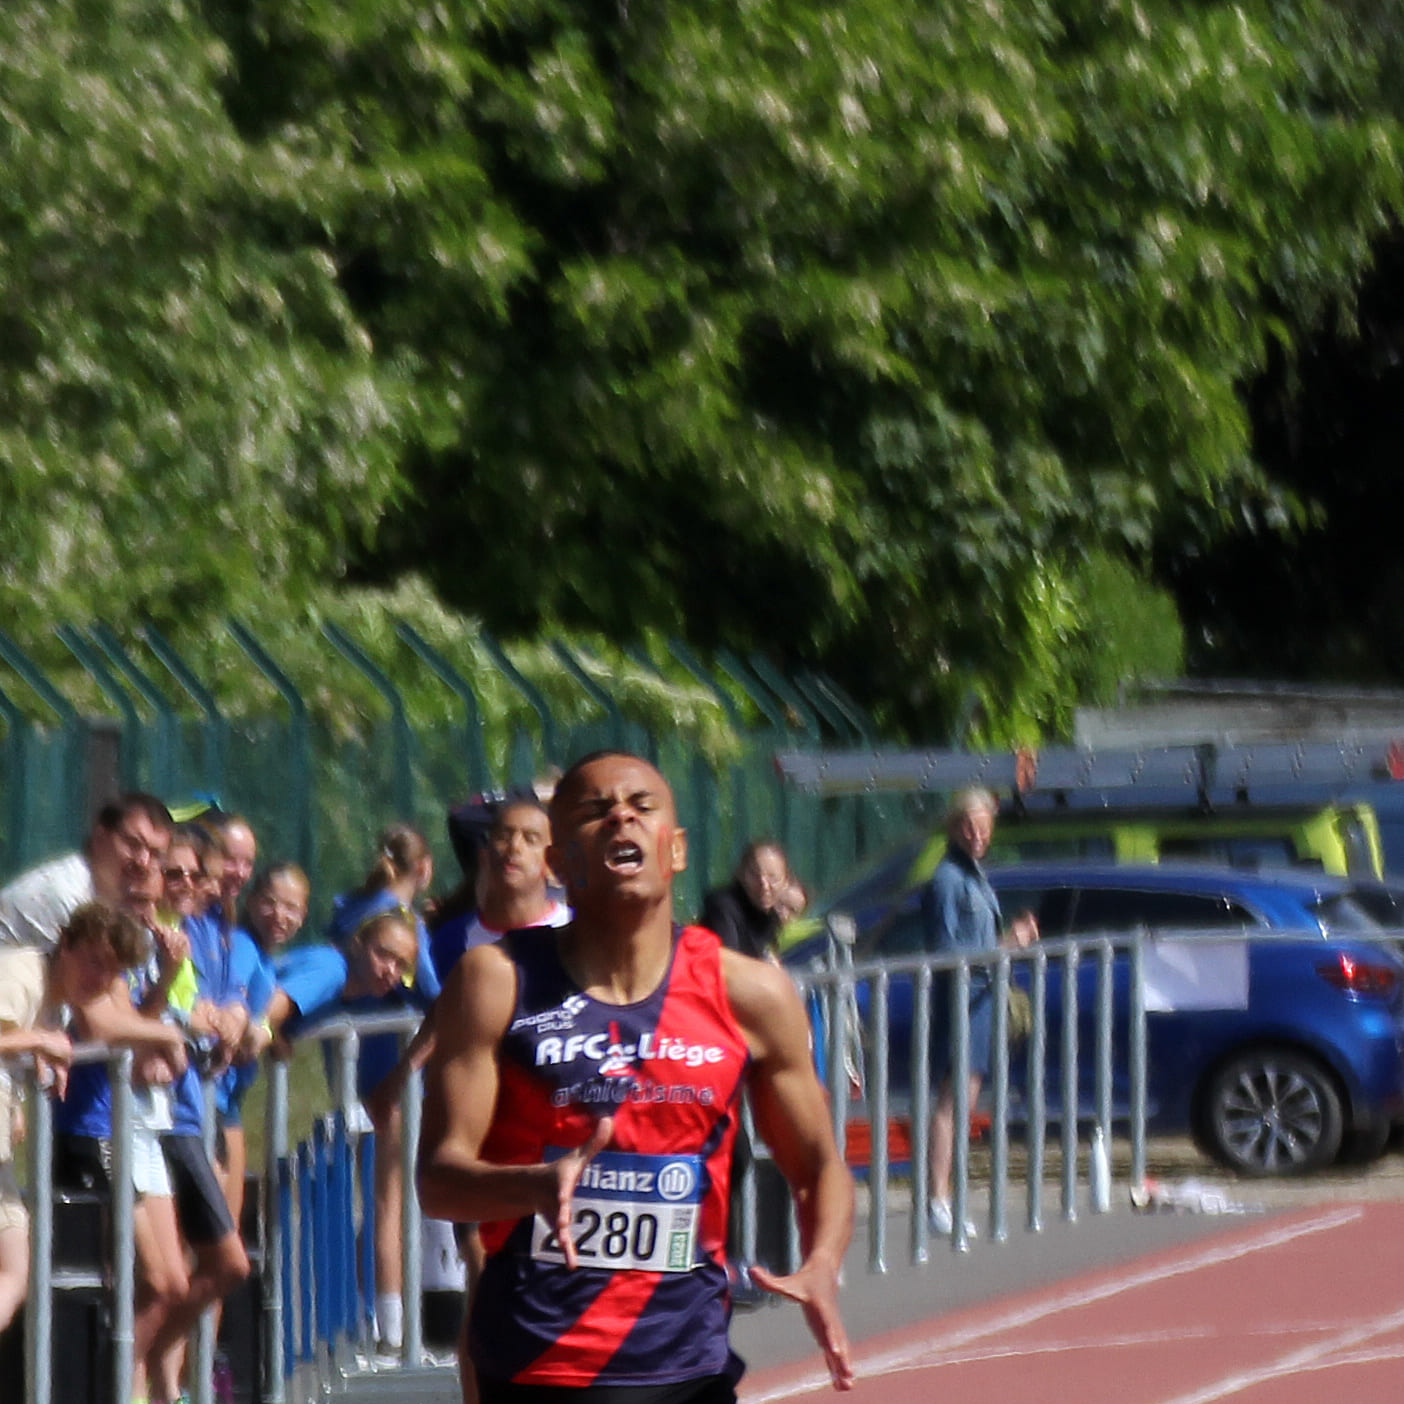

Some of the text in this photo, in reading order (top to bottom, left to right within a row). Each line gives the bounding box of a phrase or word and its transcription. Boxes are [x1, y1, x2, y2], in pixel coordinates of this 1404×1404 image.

[535, 1032, 724, 1067] RFC Liège
[576, 1163, 655, 1193] lianz
